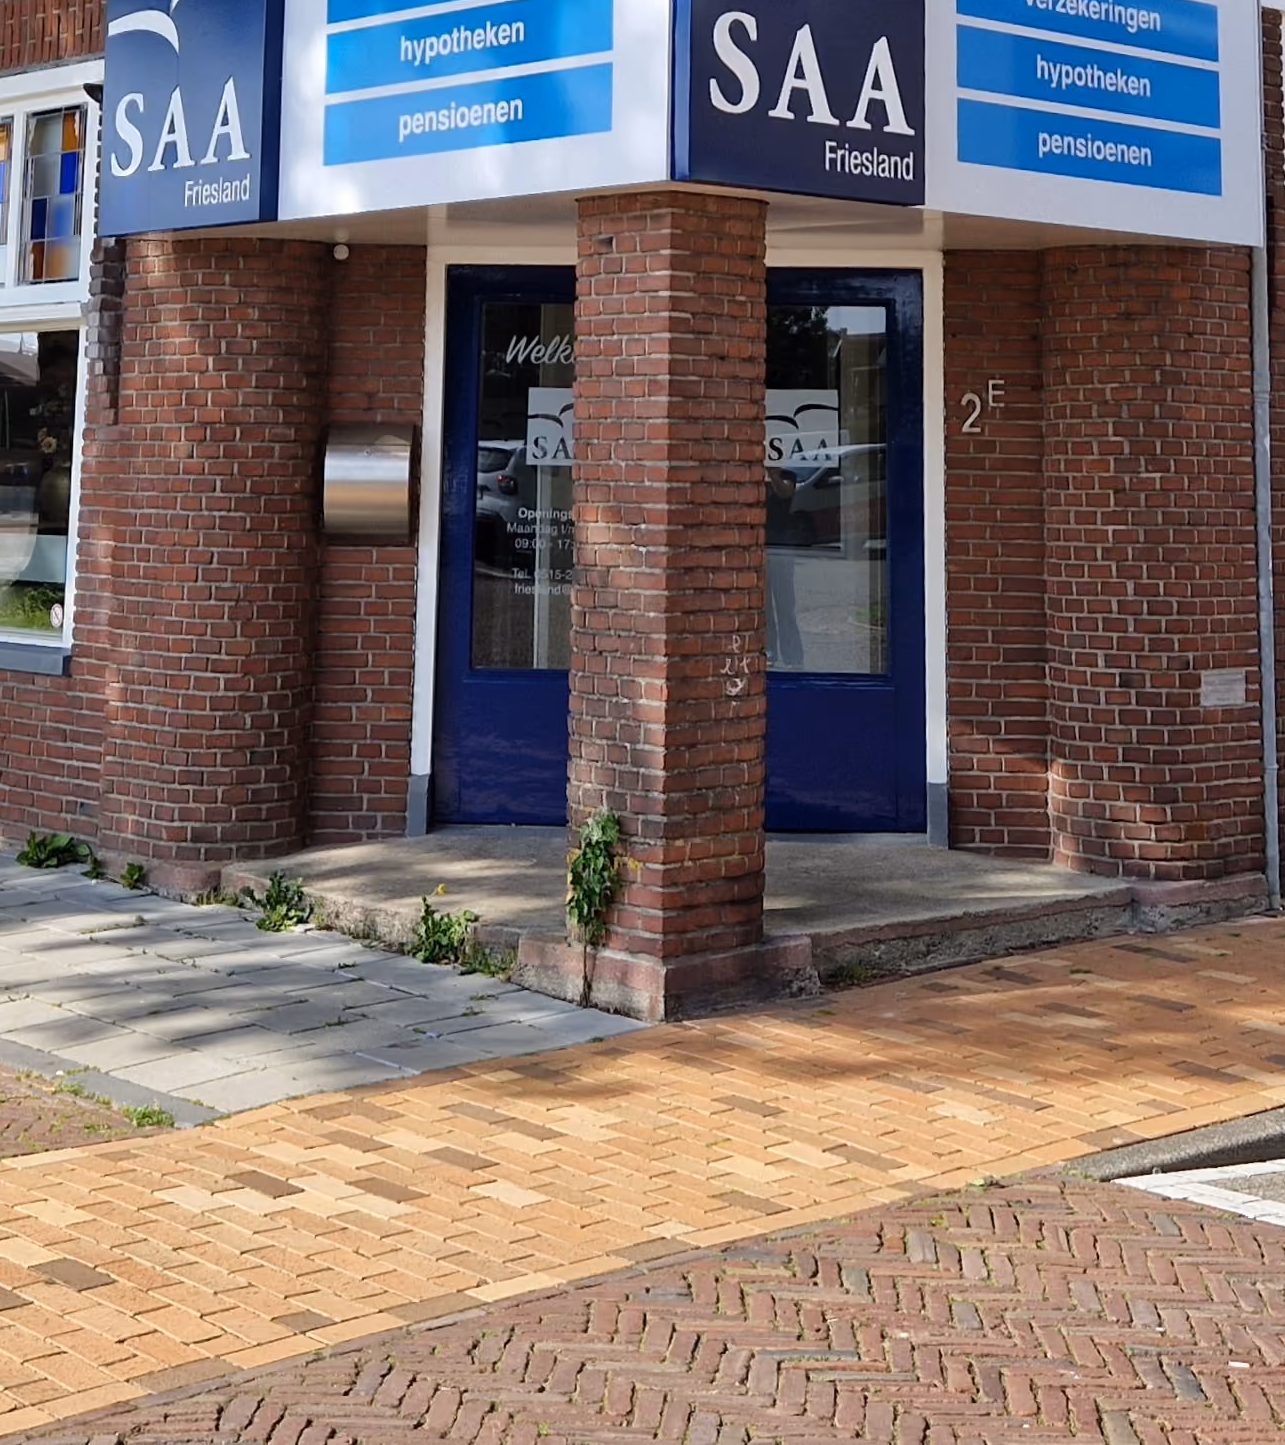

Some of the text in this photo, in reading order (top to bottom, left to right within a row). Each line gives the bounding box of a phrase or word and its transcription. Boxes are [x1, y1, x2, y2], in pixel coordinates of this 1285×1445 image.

[399, 19, 525, 66] hypotheken
[709, 11, 916, 136] SAA
[1036, 55, 1151, 98] hypotheken
[110, 76, 251, 178] SAA
[398, 98, 523, 142] pensioenen
[825, 140, 915, 182] Friesland
[1038, 130, 1152, 168] pensioenen
[184, 173, 251, 207] Friesland
[505, 335, 575, 364] Welk
[531, 435, 573, 460] SA
[767, 436, 833, 461] SAA
